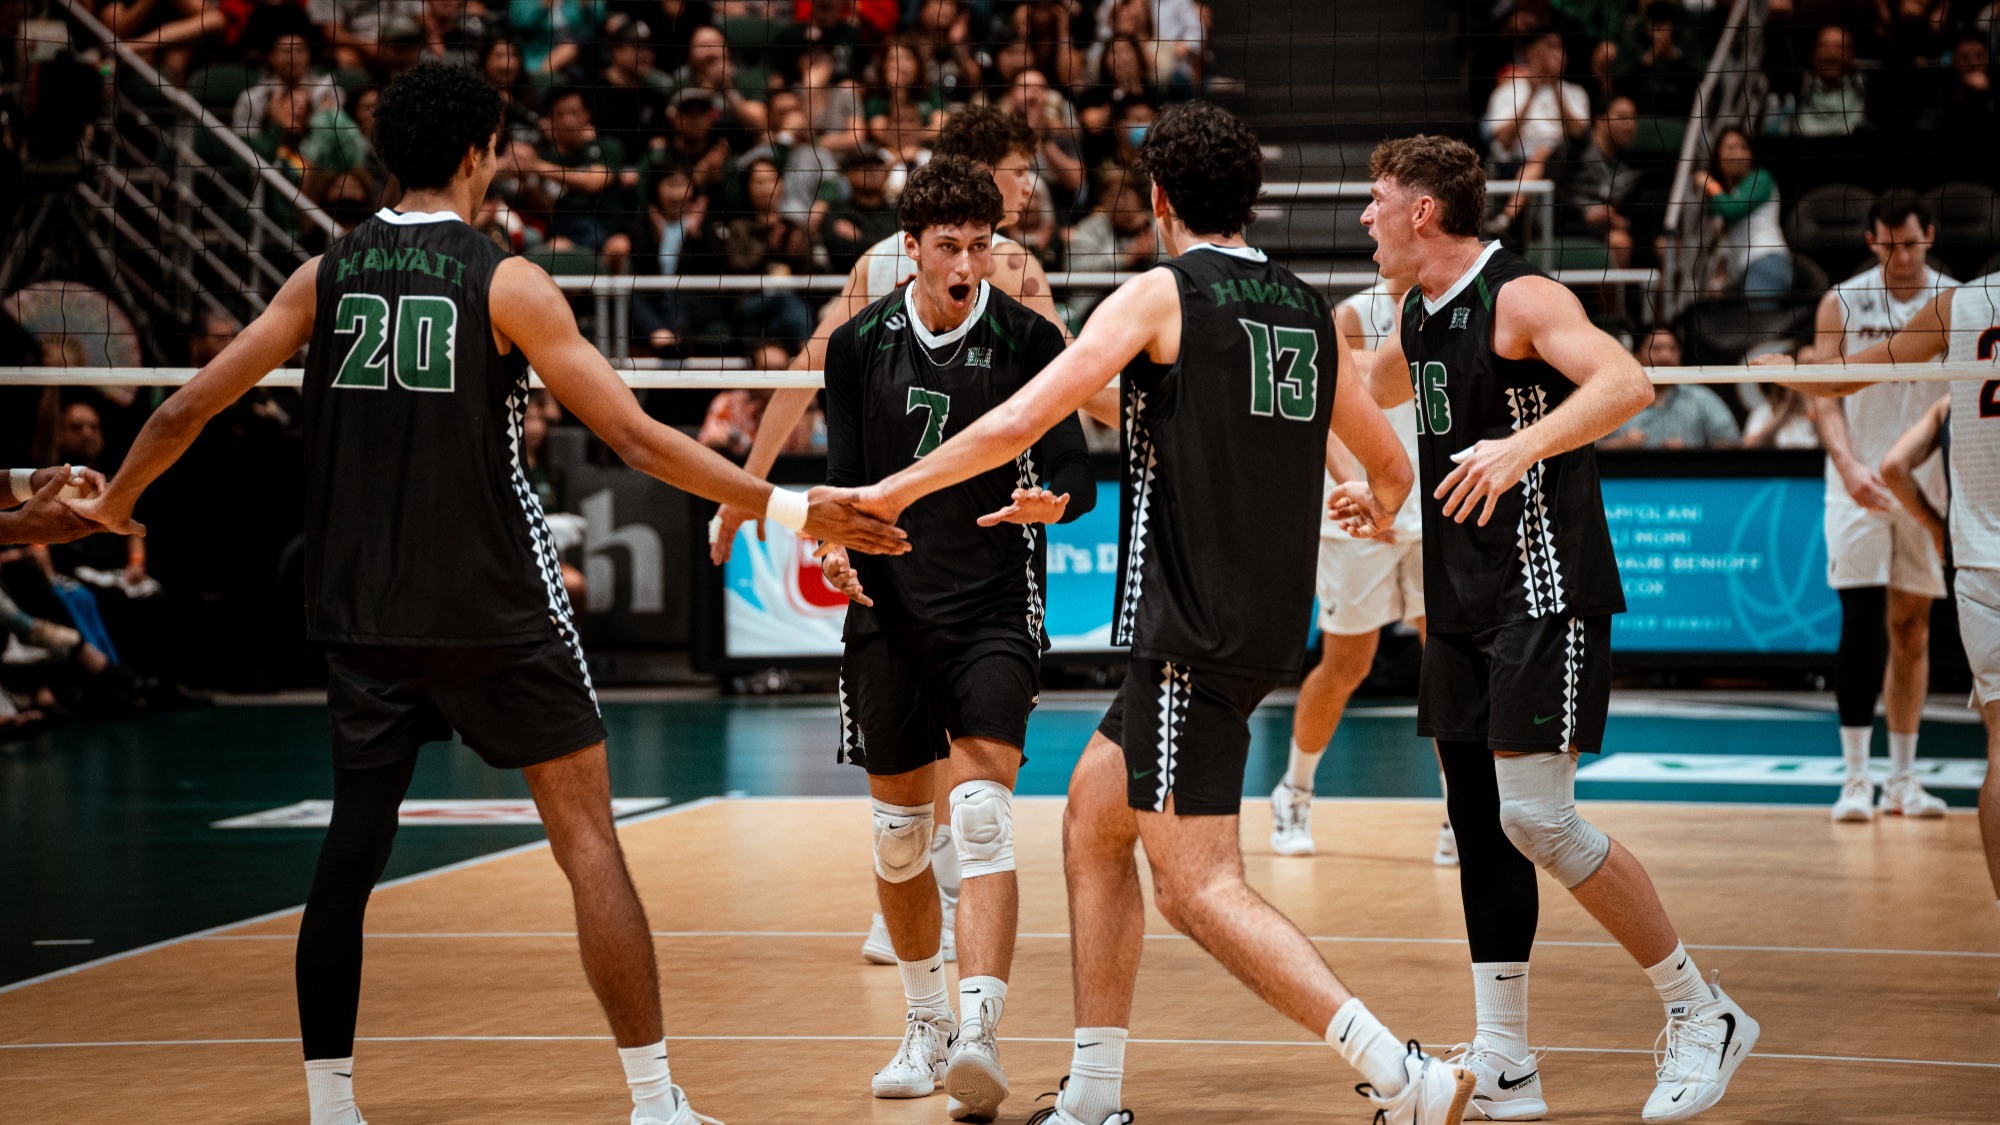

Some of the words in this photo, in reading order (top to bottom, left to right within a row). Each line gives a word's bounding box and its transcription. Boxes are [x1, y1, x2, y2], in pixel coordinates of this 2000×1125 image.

[331, 293, 458, 392] 20
[1238, 318, 1319, 422] 13
[906, 386, 950, 459] 7
[1411, 361, 1452, 435] 16
[1671, 1006, 1685, 1014] NIKE
